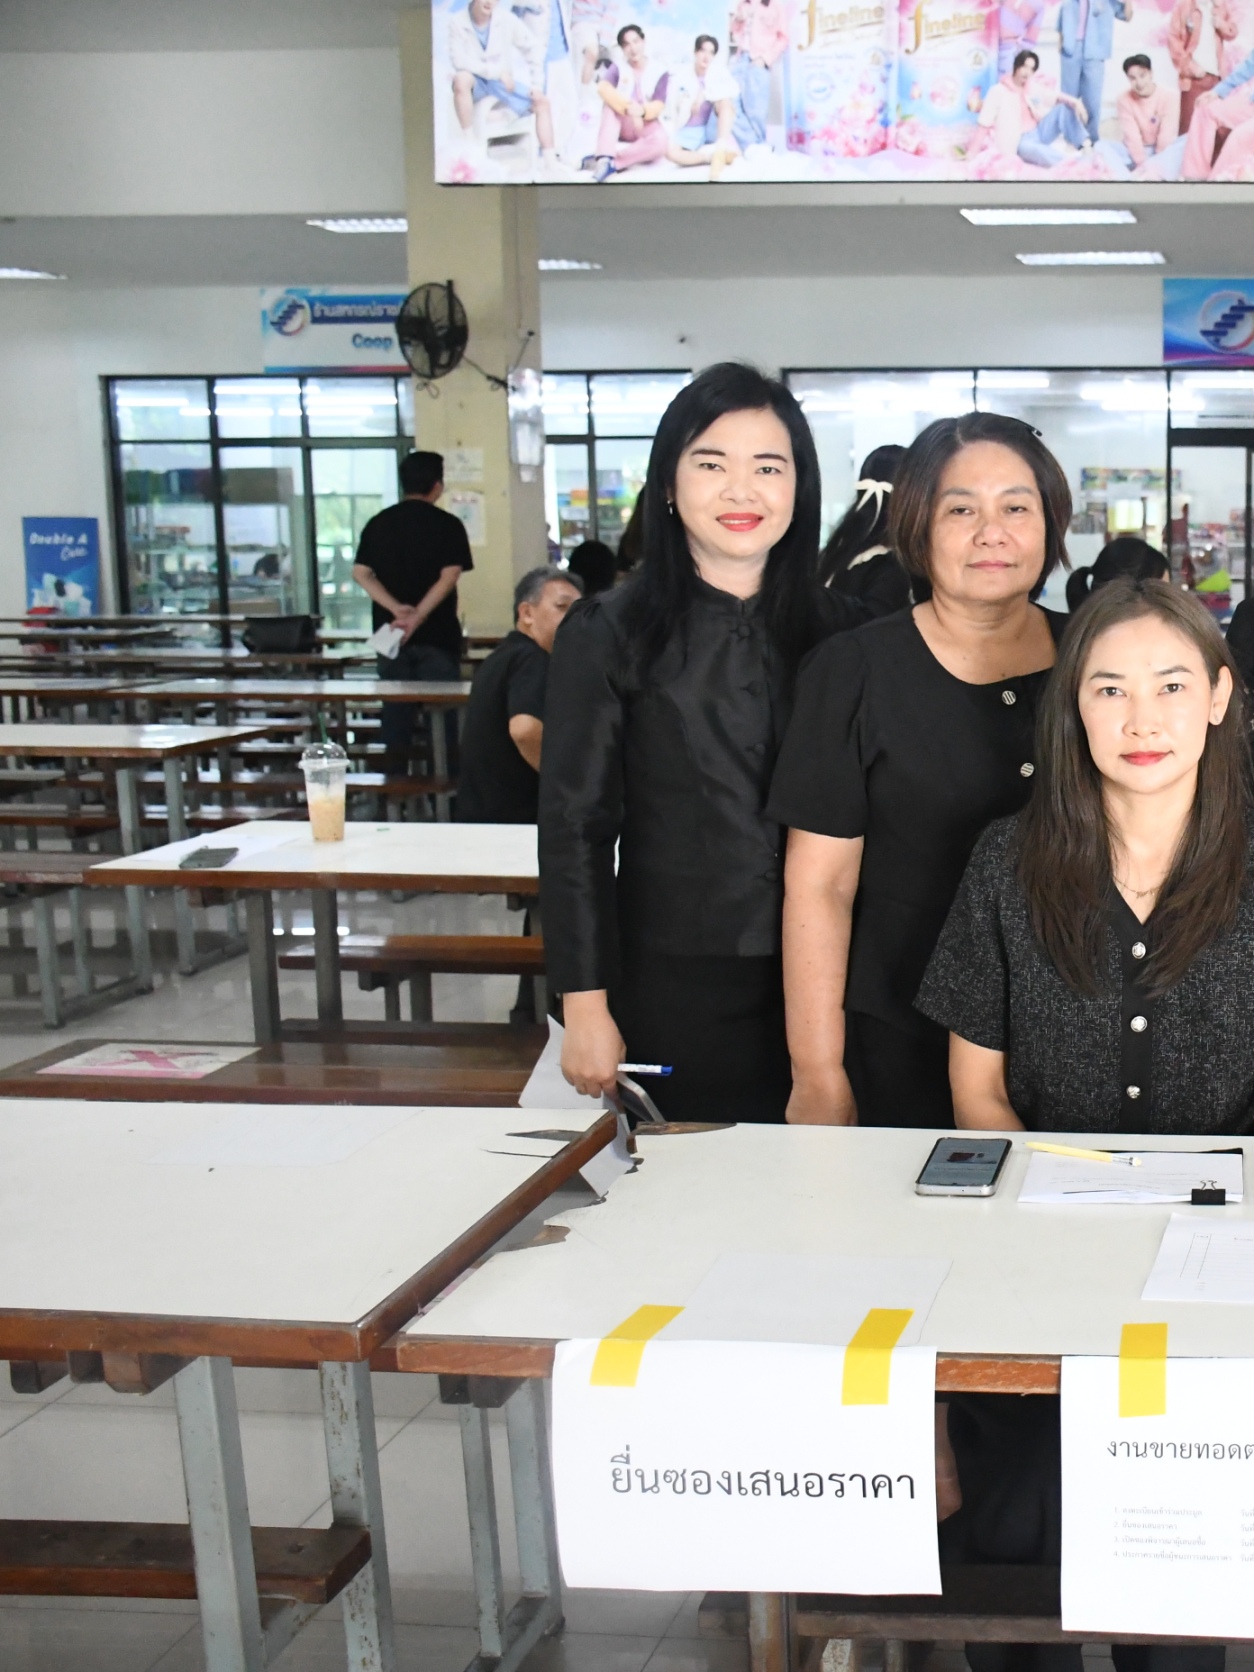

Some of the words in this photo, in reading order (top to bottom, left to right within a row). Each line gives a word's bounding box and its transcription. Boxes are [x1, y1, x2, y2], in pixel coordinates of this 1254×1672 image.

[610, 1444, 915, 1500] ยื่นซองเสนอราคา
